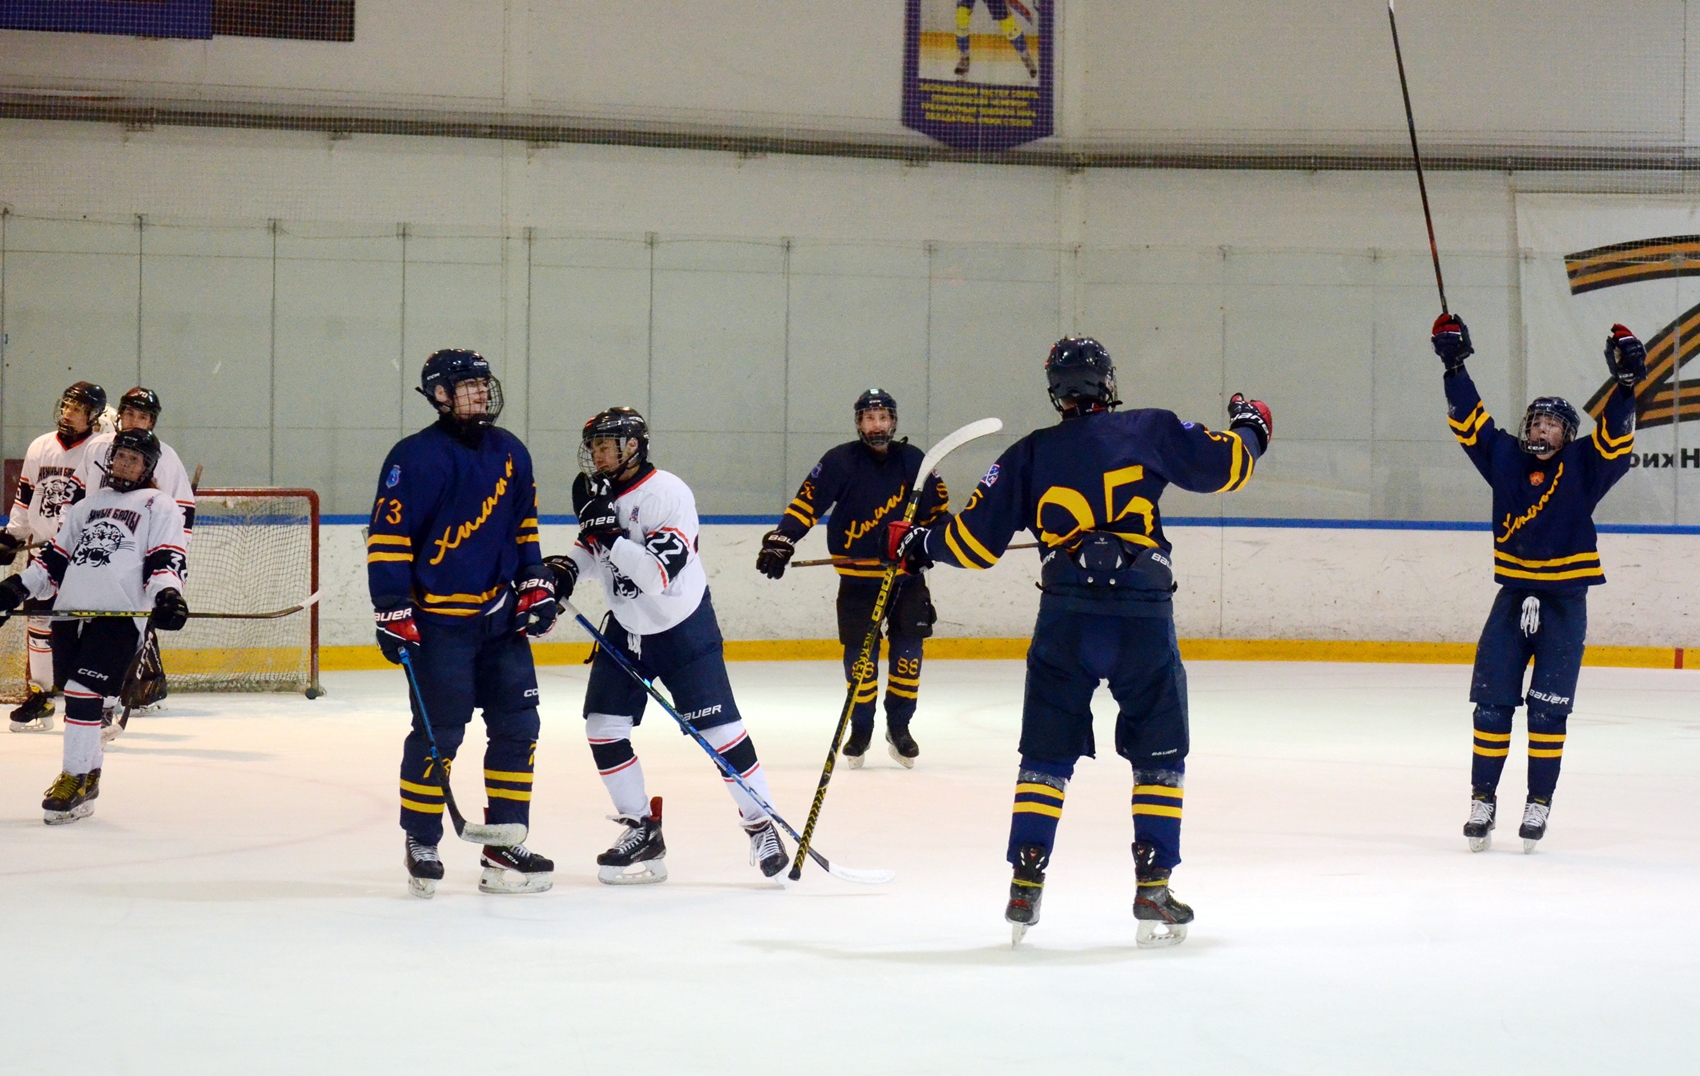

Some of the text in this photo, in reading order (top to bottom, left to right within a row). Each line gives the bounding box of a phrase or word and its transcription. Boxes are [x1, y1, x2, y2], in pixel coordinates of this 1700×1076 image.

[1629, 447, 1700, 469] оих Н
[646, 532, 684, 566] 22
[1151, 552, 1172, 569] BAU
[518, 578, 555, 594] BAUE
[374, 607, 412, 622] AUER
[77, 668, 109, 681] CCM
[897, 657, 919, 675] 88
[523, 688, 539, 698] CC
[1529, 688, 1570, 705] BAUER
[683, 704, 722, 721] AUER
